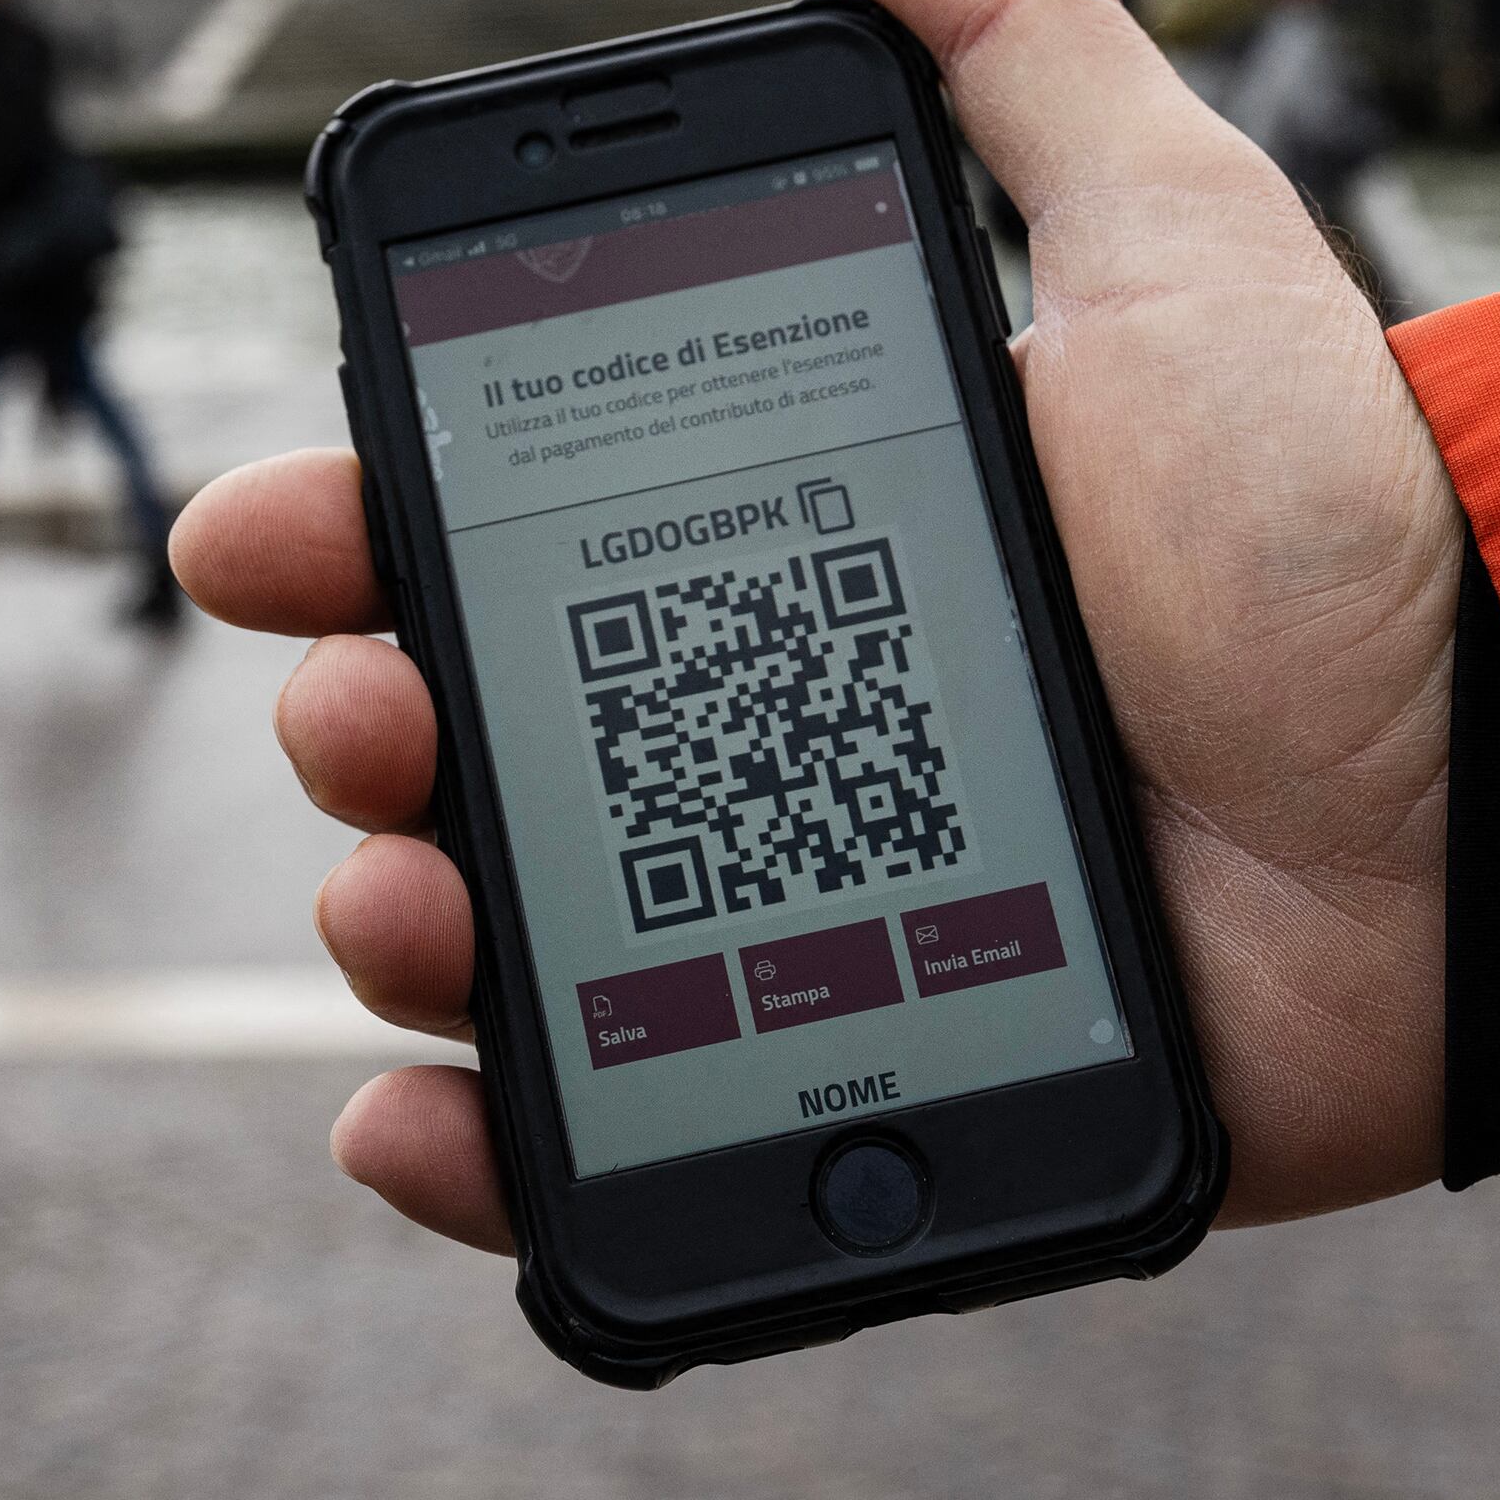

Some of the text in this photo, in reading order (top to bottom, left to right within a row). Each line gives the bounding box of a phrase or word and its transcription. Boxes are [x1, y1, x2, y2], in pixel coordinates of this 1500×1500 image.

[484, 308, 870, 408] Il tuo codice di Esenzione
[484, 342, 884, 440] Utilizza il tuo codice per ottenere l'esenzione
[508, 376, 877, 467] dal pagamento del contributo di accesso.
[579, 495, 790, 569] LGDOGBPK
[923, 940, 1022, 976] Invia Email
[761, 982, 831, 1014] Stampa
[598, 1026, 648, 1048] Salva
[798, 1071, 901, 1119] NOME
